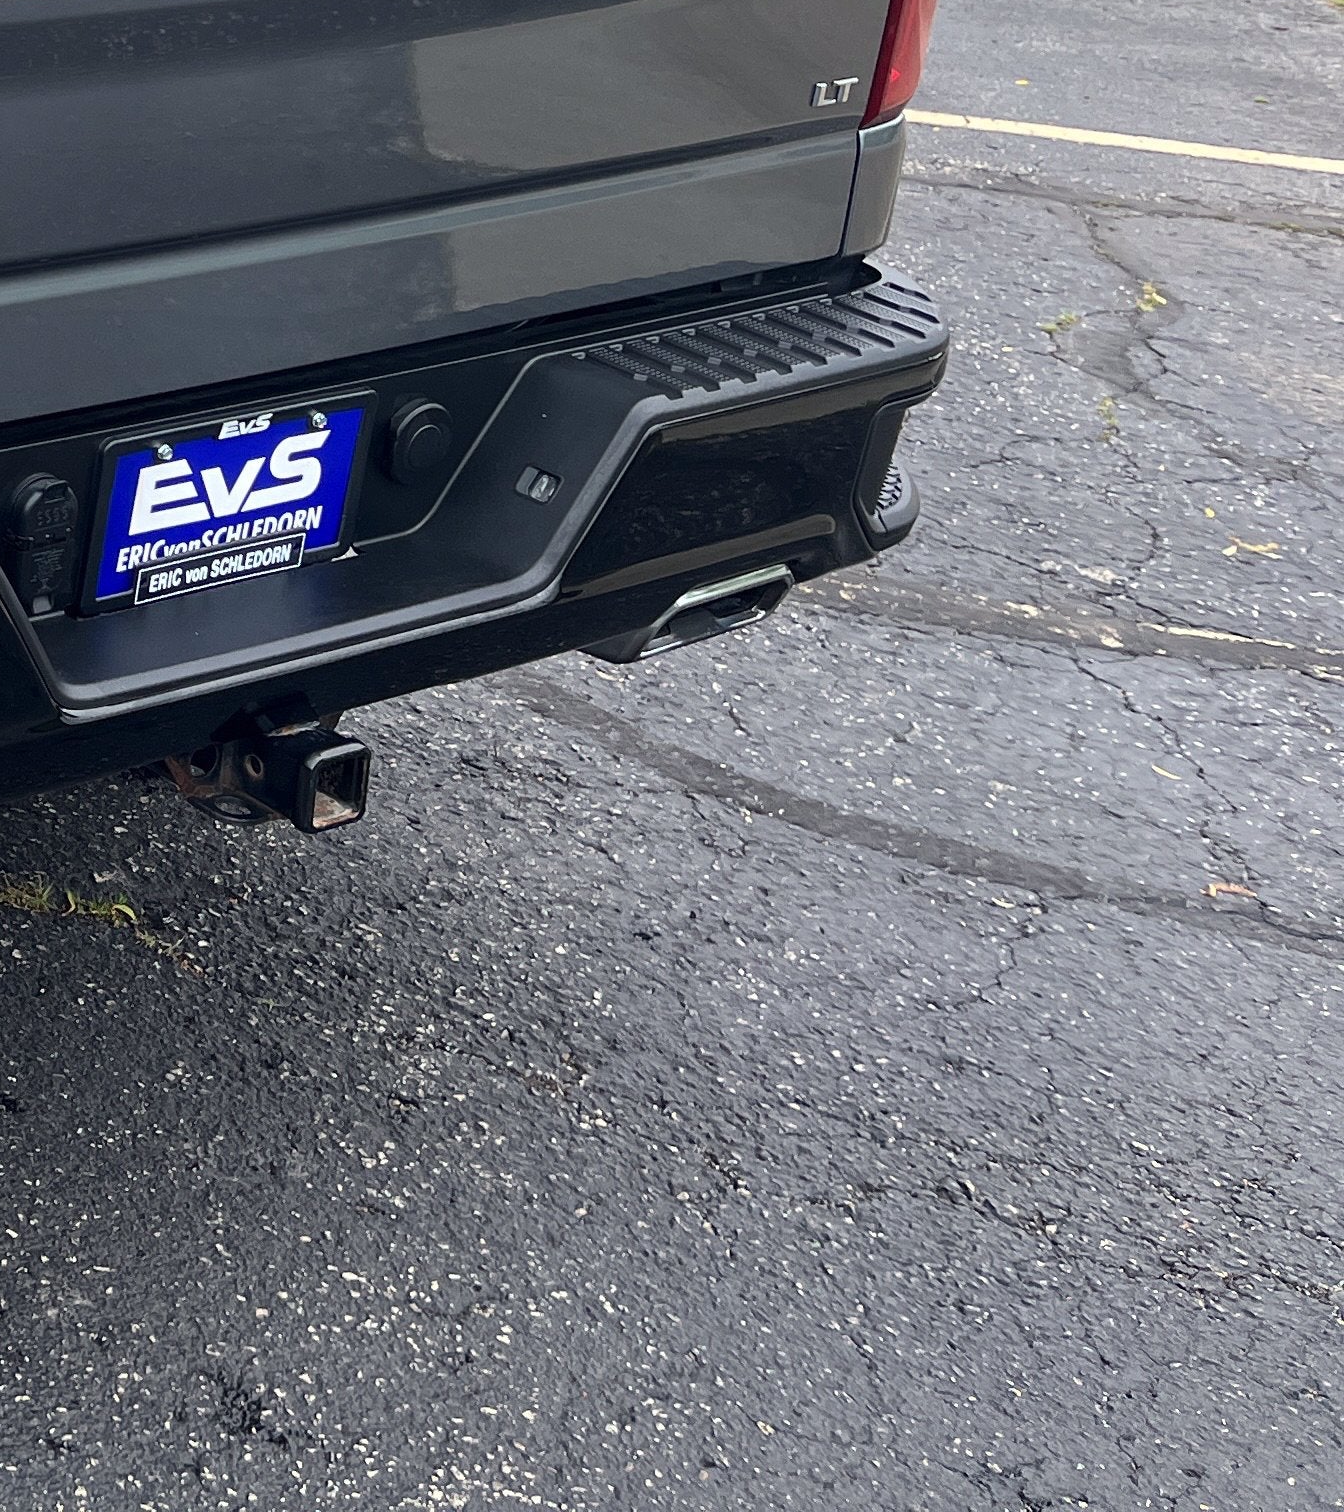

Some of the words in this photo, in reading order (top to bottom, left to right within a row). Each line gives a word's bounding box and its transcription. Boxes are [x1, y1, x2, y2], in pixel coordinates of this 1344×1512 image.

[811, 76, 860, 107] LT
[148, 567, 182, 593] ERIC
[185, 564, 208, 584] von
[210, 542, 292, 578] SCHLEDORN
